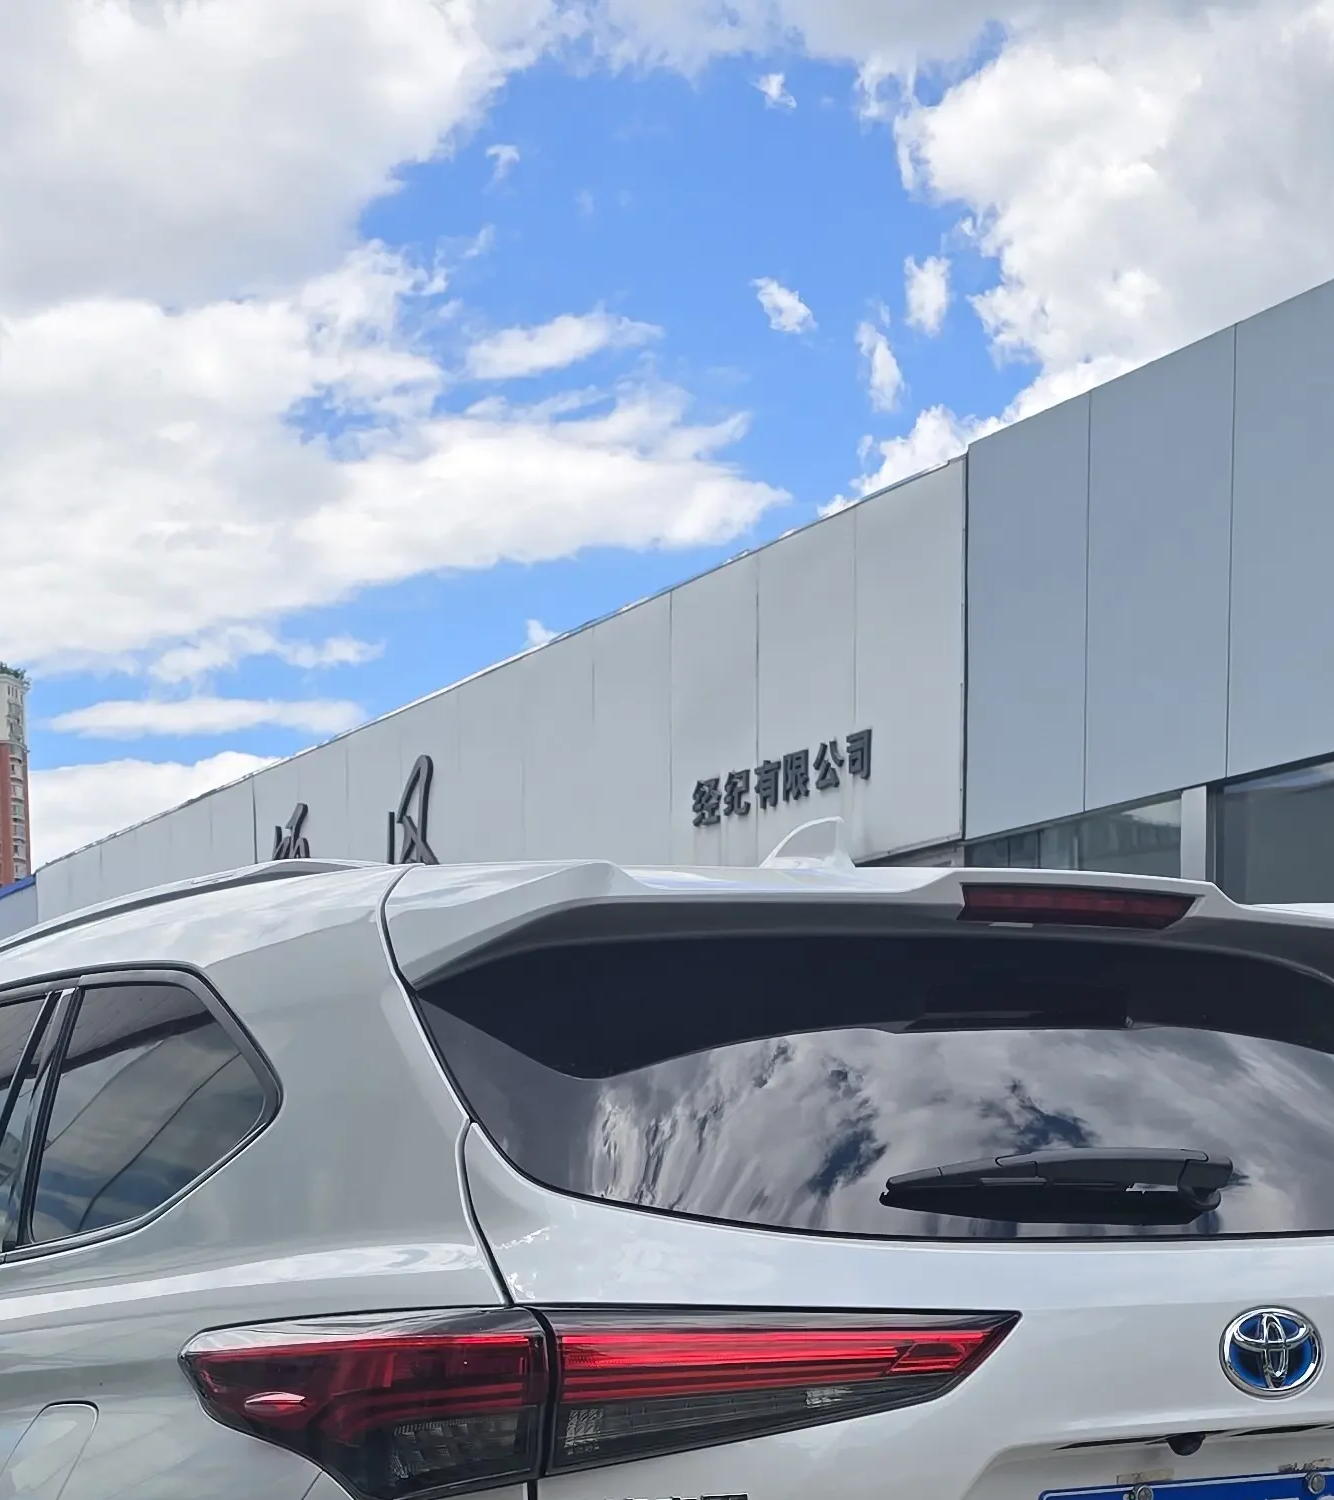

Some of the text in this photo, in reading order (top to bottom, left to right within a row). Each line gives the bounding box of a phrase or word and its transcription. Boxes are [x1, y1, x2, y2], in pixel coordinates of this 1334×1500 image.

[692, 729, 872, 827] 经纪有限公司
